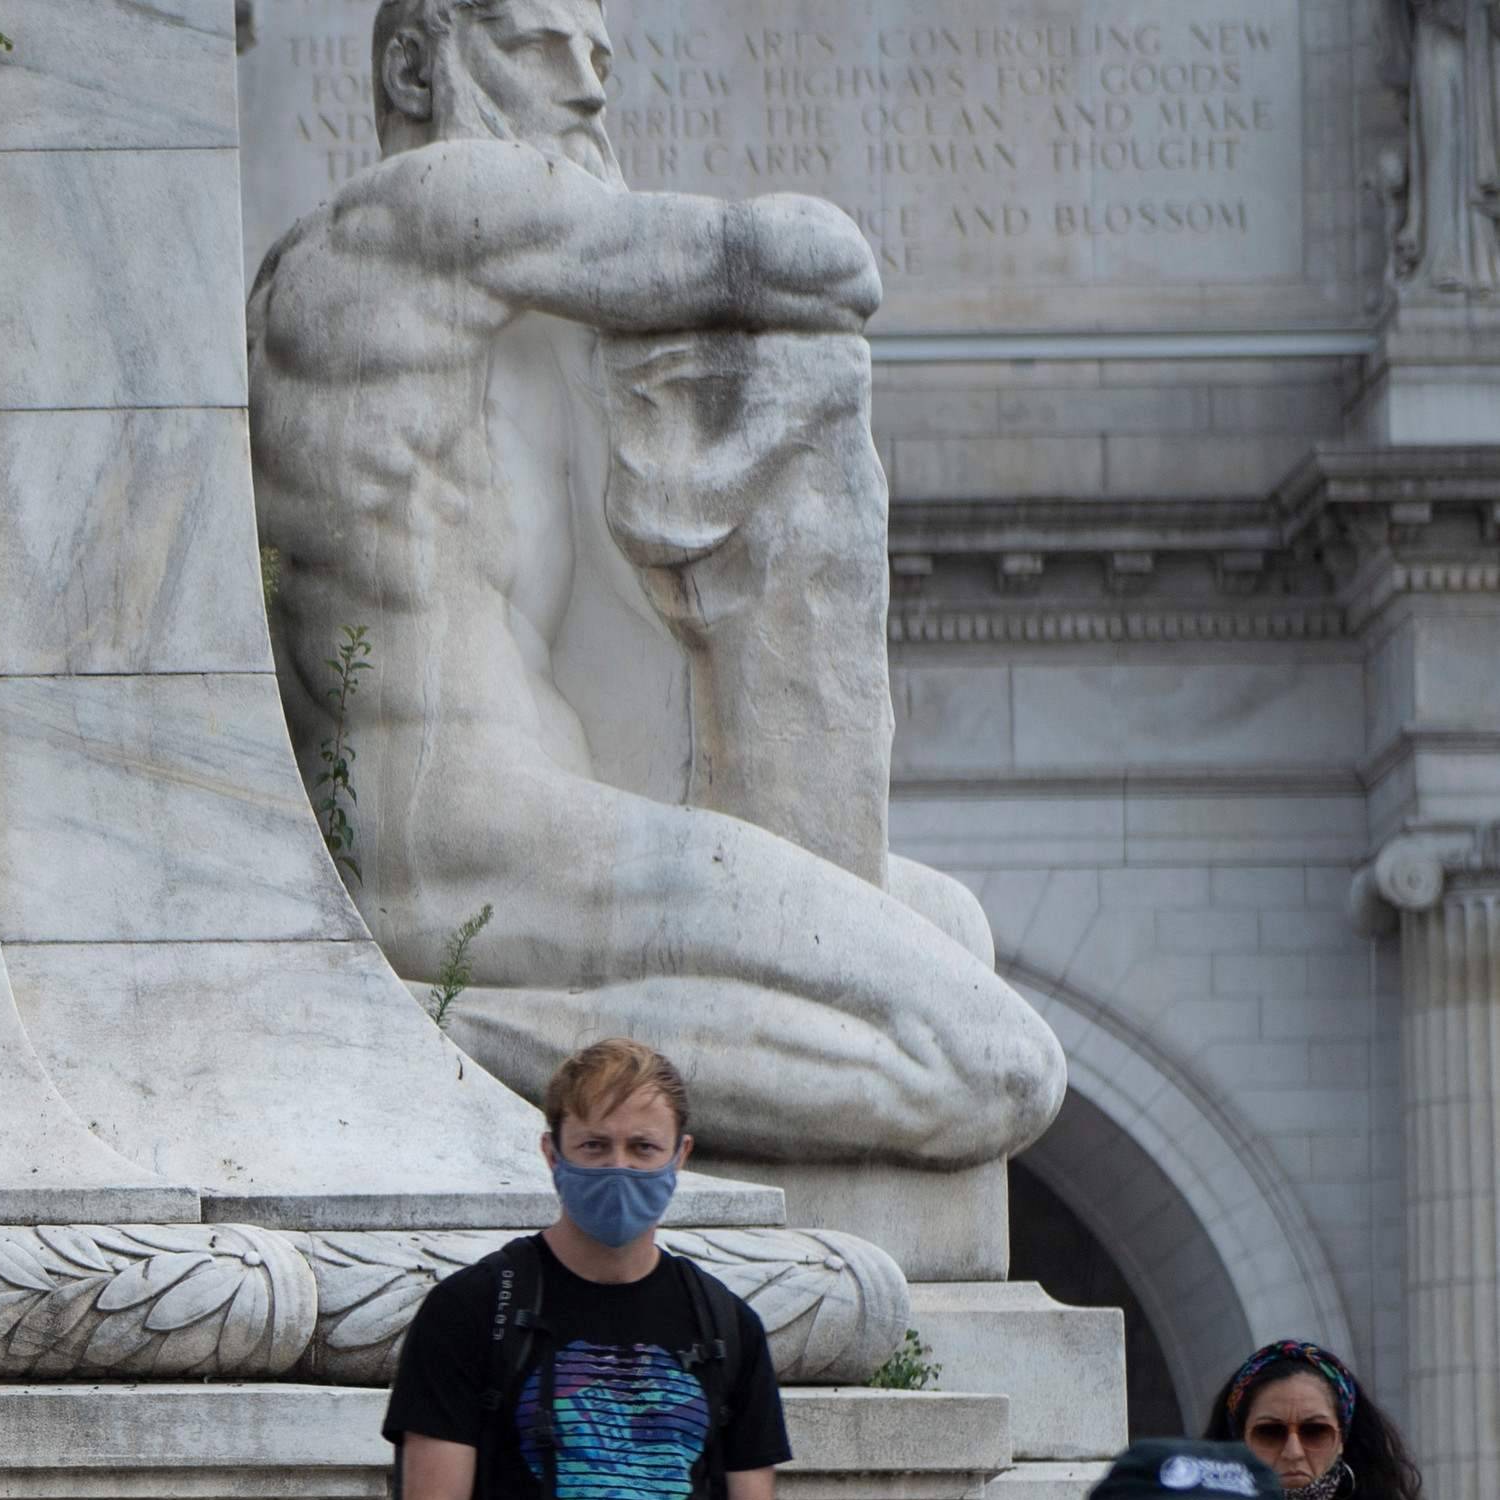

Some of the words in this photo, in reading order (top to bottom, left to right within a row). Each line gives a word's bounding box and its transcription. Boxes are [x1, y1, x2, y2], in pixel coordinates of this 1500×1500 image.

[283, 36, 361, 66] THE
[613, 30, 712, 62] ANIC
[740, 28, 837, 61] ARTS
[877, 23, 1162, 58] CONTROLLING
[1187, 19, 1273, 54] NEW
[651, 68, 731, 98] NEW
[764, 64, 967, 98] HIGHWAYS
[997, 62, 1072, 95] FOR
[1101, 61, 1243, 95] GOODS
[764, 104, 833, 137] THE
[861, 103, 1004, 136] OCEAN
[1050, 100, 1132, 133] AND
[1157, 97, 1273, 131] MAKE
[703, 143, 840, 177] CARRY
[867, 143, 1019, 175] HUMAN
[1050, 138, 1243, 172] THOUGHT
[949, 202, 1032, 237] AND
[1054, 198, 1249, 236] BLOSSOM
